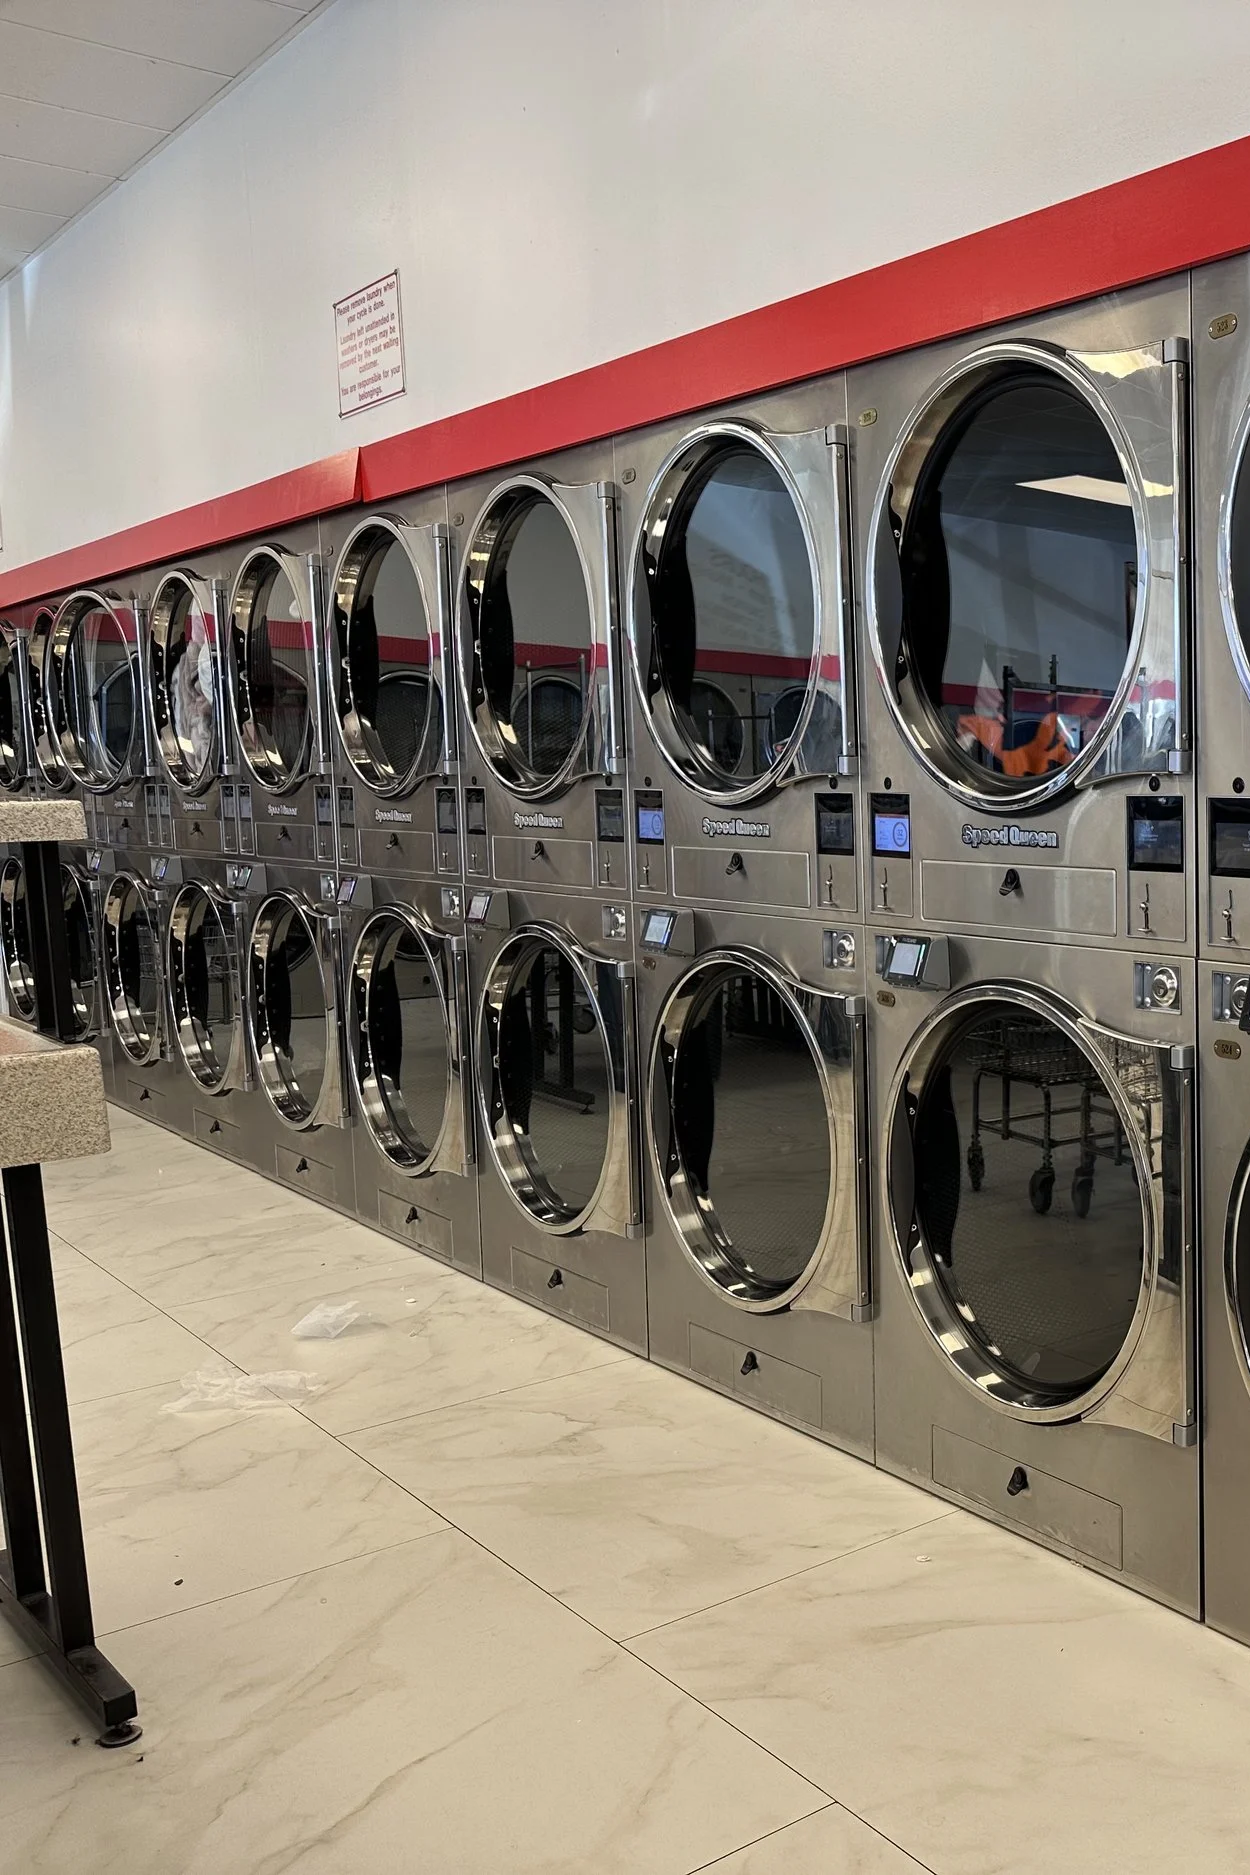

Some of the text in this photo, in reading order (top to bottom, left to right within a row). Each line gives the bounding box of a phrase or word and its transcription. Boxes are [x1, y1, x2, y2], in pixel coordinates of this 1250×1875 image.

[336, 281, 396, 317] Please remove laundry when
[347, 300, 386, 326] your cycle is done.
[340, 313, 395, 346] Laundry left unattended in
[358, 341, 364, 349] or
[364, 335, 378, 347] dryers
[378, 330, 389, 339] may
[389, 326, 396, 335] be
[339, 337, 399, 370] removed by the next waiting
[341, 388, 349, 397] You
[357, 373, 382, 389] responsible
[382, 370, 390, 379] for
[390, 365, 401, 378] your
[513, 811, 538, 830] Speed
[702, 816, 770, 837] Speed Queen
[961, 824, 1059, 848] Speed Queen
